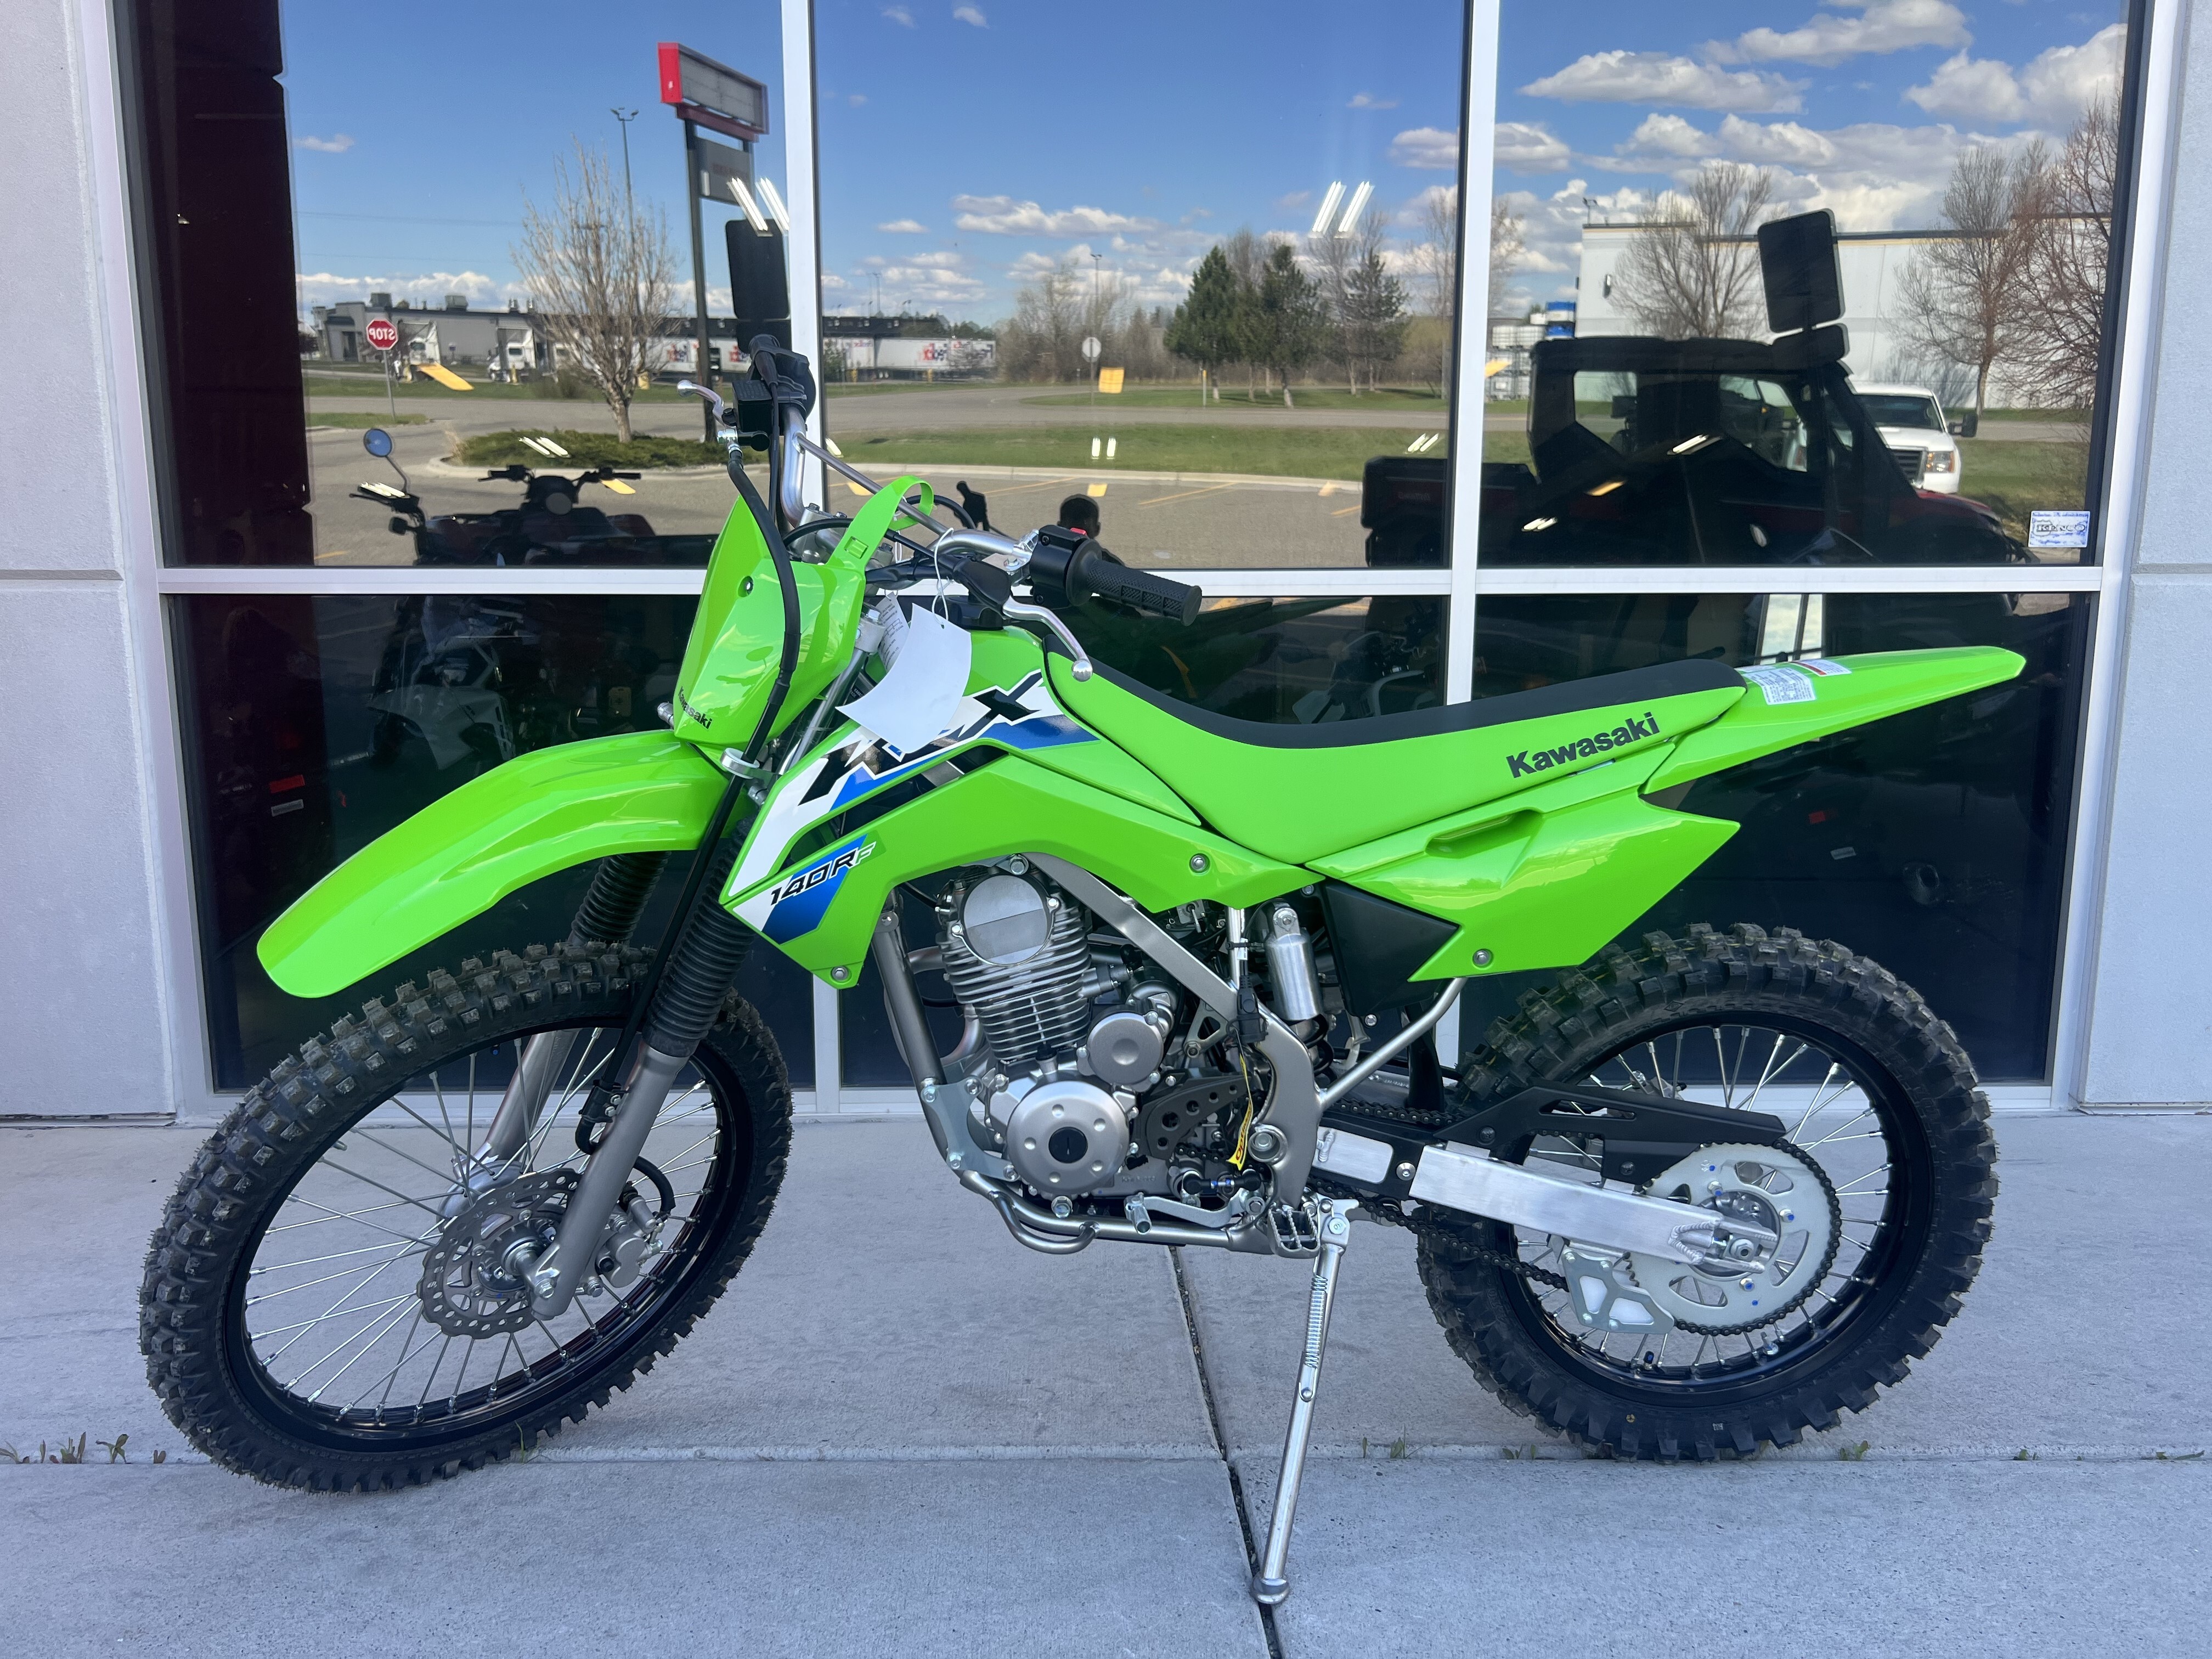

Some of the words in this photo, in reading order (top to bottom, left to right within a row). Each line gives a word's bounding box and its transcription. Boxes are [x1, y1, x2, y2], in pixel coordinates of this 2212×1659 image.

[678, 686, 713, 730] Kawasaki
[1505, 712, 1660, 778] Kawasaki
[770, 841, 877, 906] 140RF
